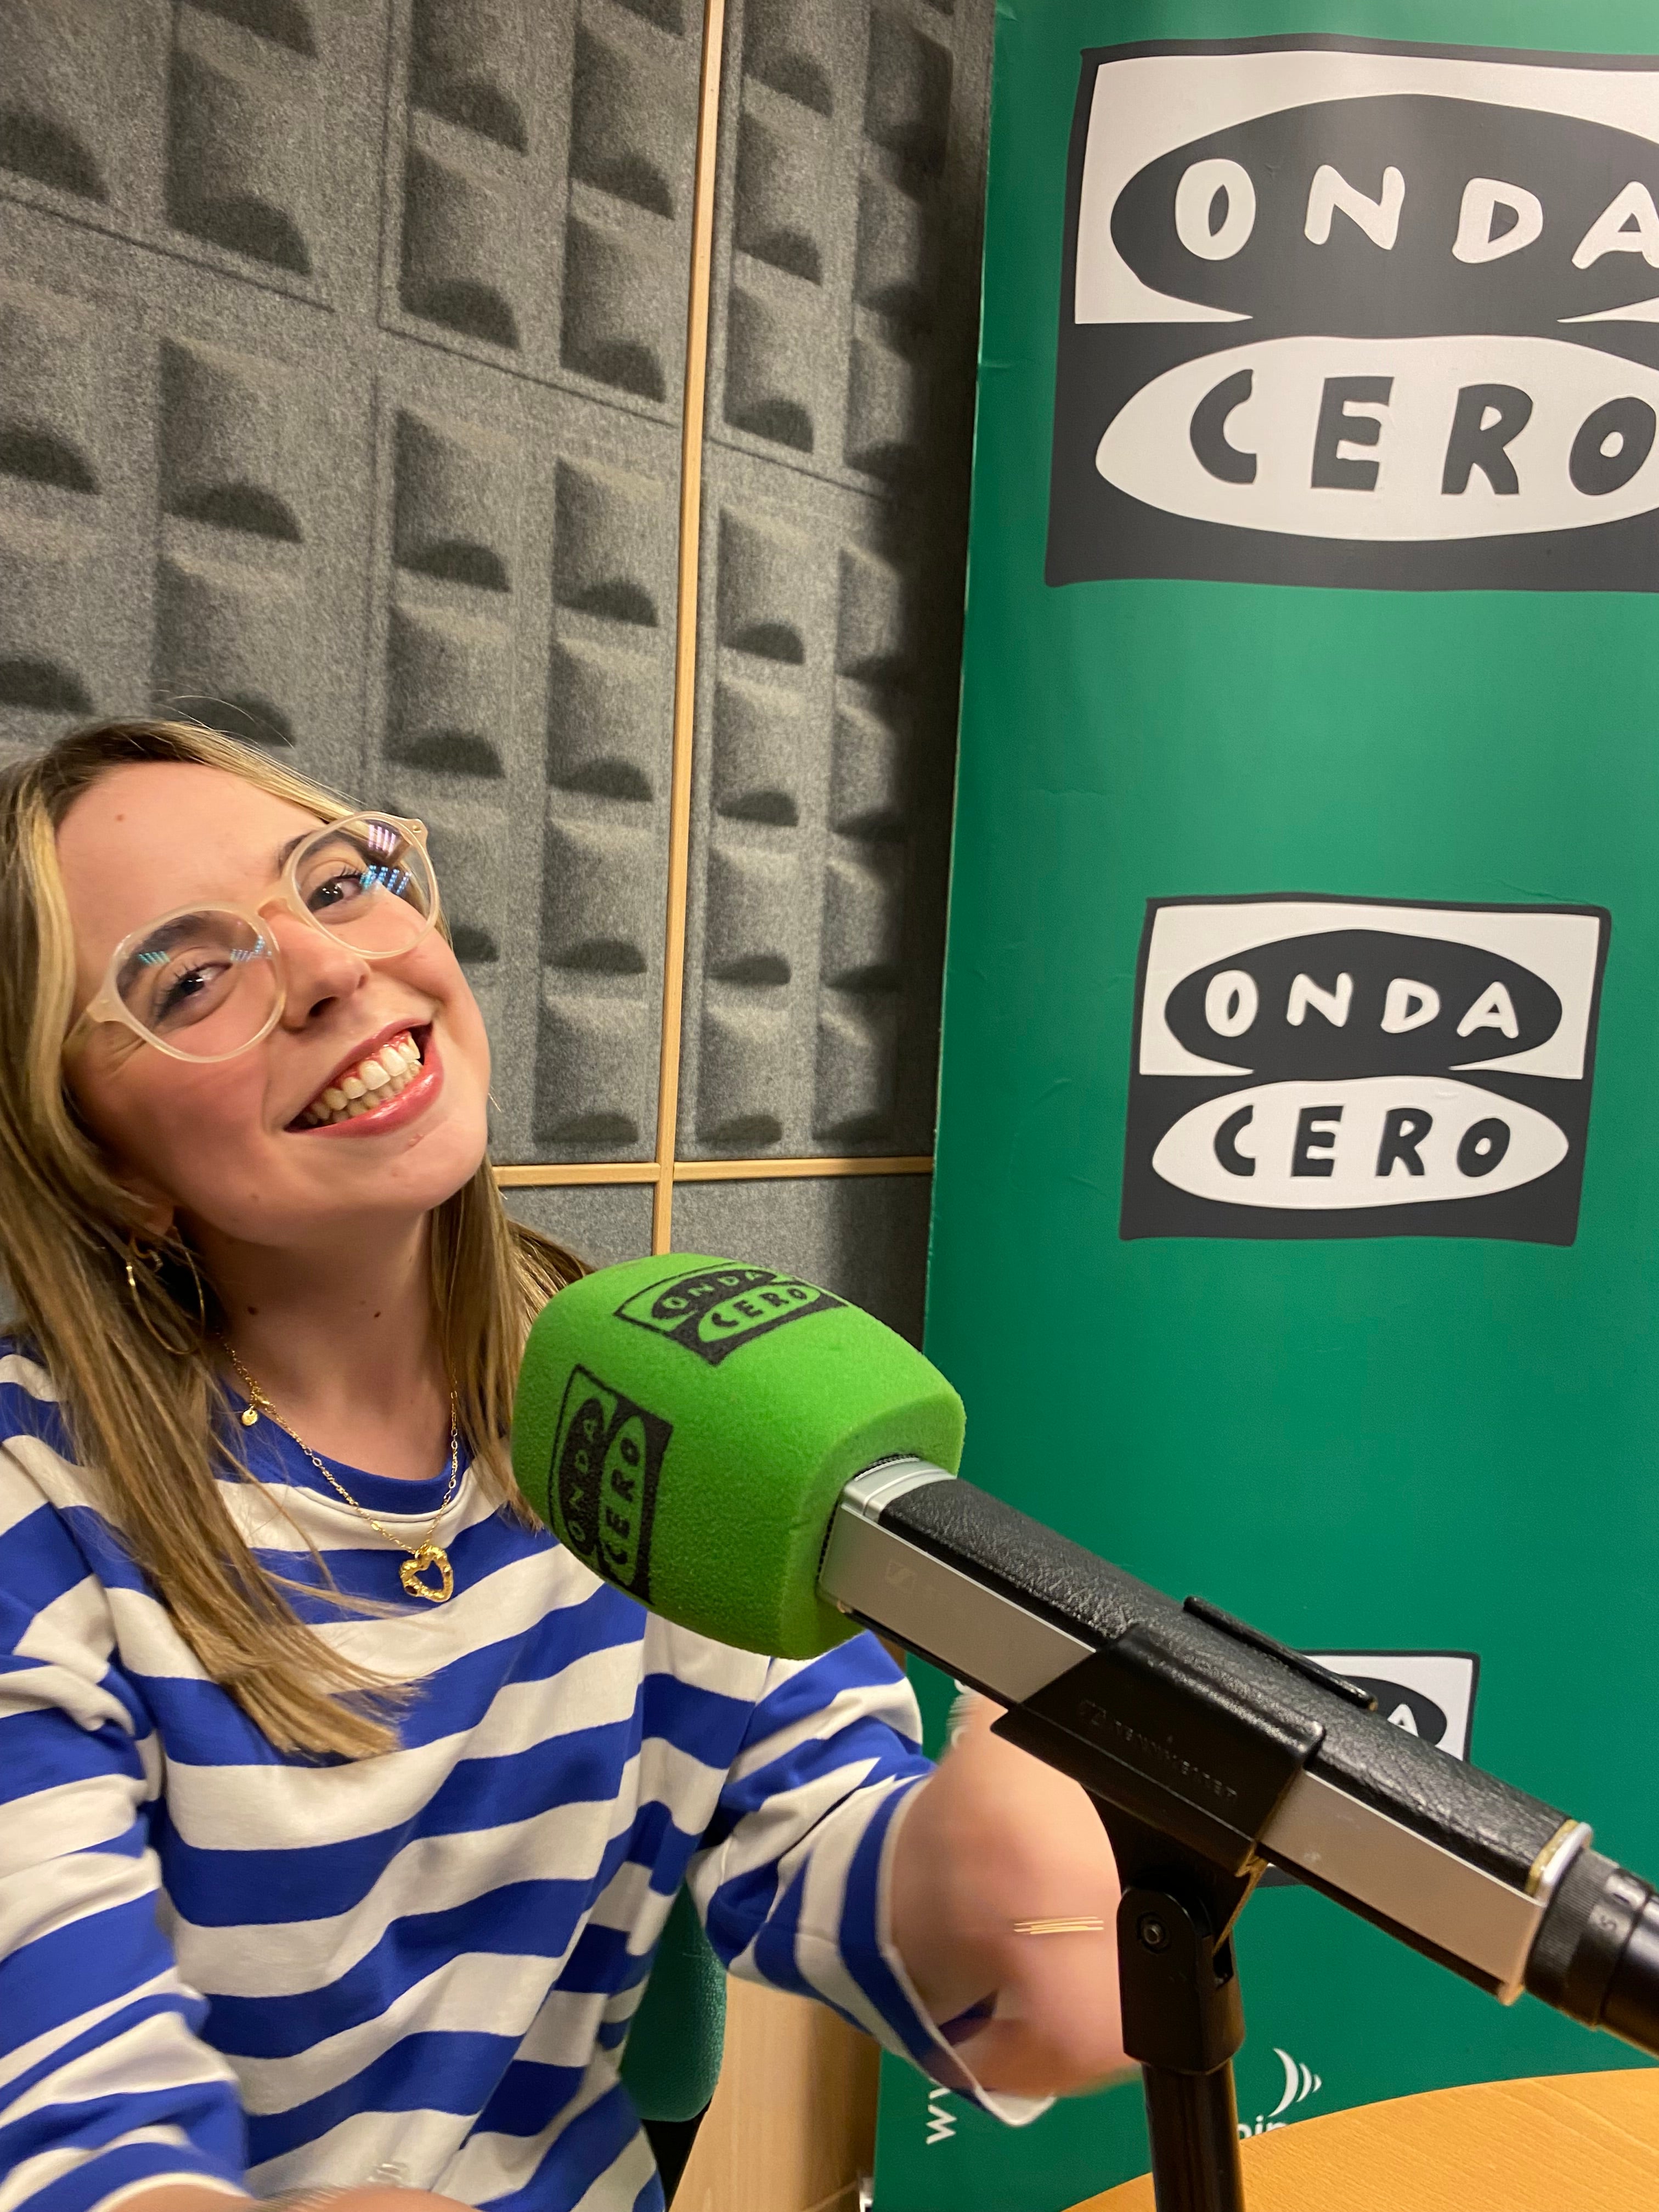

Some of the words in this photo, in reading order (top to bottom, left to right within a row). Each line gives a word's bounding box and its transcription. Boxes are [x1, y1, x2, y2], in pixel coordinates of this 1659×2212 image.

[1175, 158, 1659, 269] ONDA
[1189, 368, 1657, 496] CERO
[1205, 969, 1519, 1039] ONDA
[1214, 1104, 1511, 1178] CERO
[662, 1270, 763, 1310] ONDA
[711, 1288, 808, 1328] CERO
[569, 1418, 596, 1542] ONDA
[605, 1437, 641, 1565] CERO
